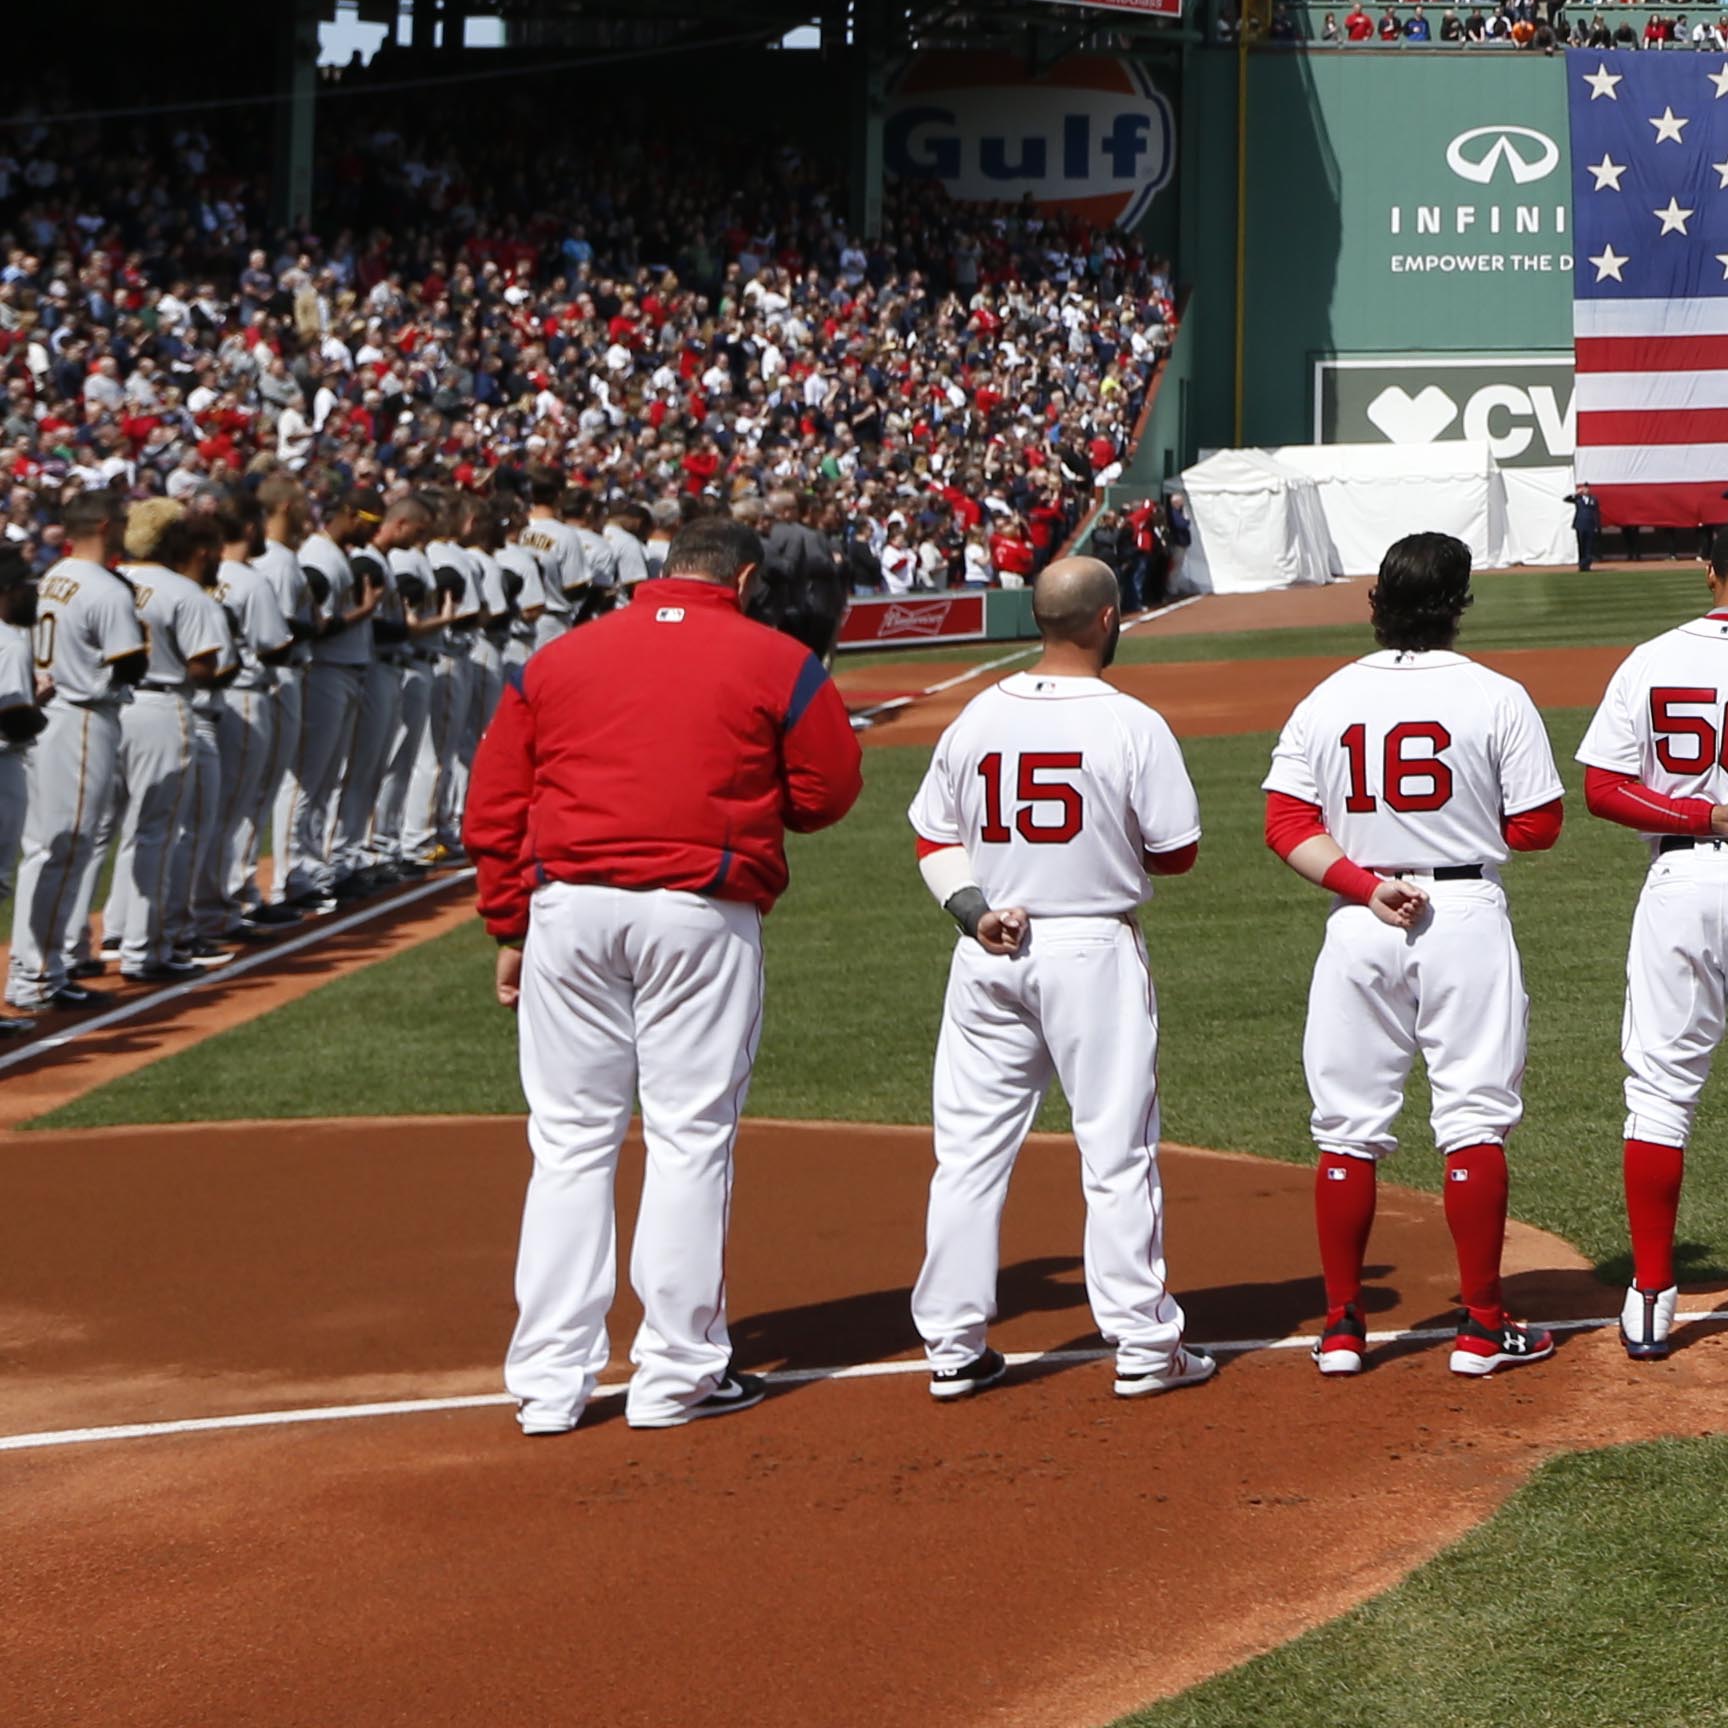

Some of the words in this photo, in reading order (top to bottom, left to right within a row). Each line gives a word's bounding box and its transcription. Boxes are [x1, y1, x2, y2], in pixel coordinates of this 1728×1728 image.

[882, 105, 1151, 180] Gulf
[1391, 254, 1505, 273] EMPOWER
[1510, 255, 1553, 272] THE
[976, 750, 1084, 845] 15
[1340, 720, 1454, 815] 16
